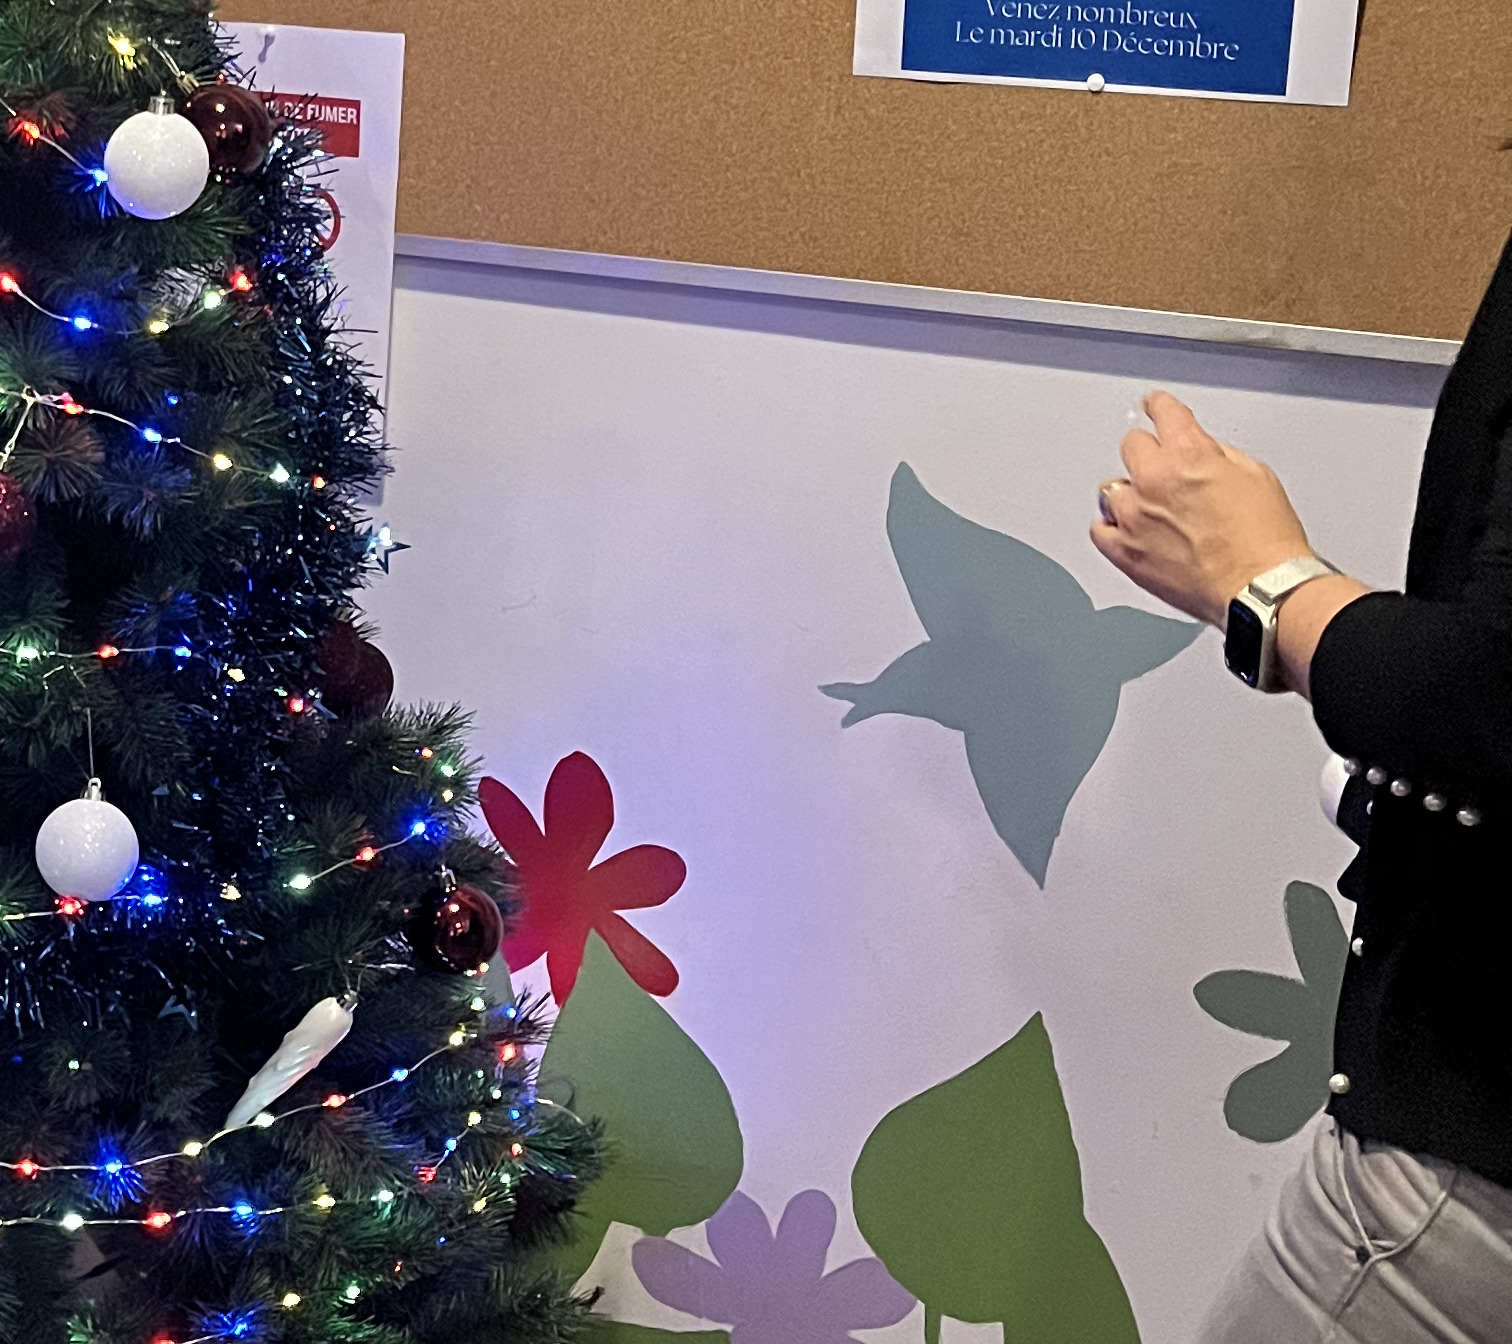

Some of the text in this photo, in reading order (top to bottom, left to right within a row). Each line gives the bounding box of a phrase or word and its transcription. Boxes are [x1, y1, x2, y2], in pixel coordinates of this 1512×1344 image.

[1066, 1, 1198, 29] nombreux
[956, 21, 1239, 61] Le mardi 10 Décembre
[307, 104, 357, 124] FUMER
